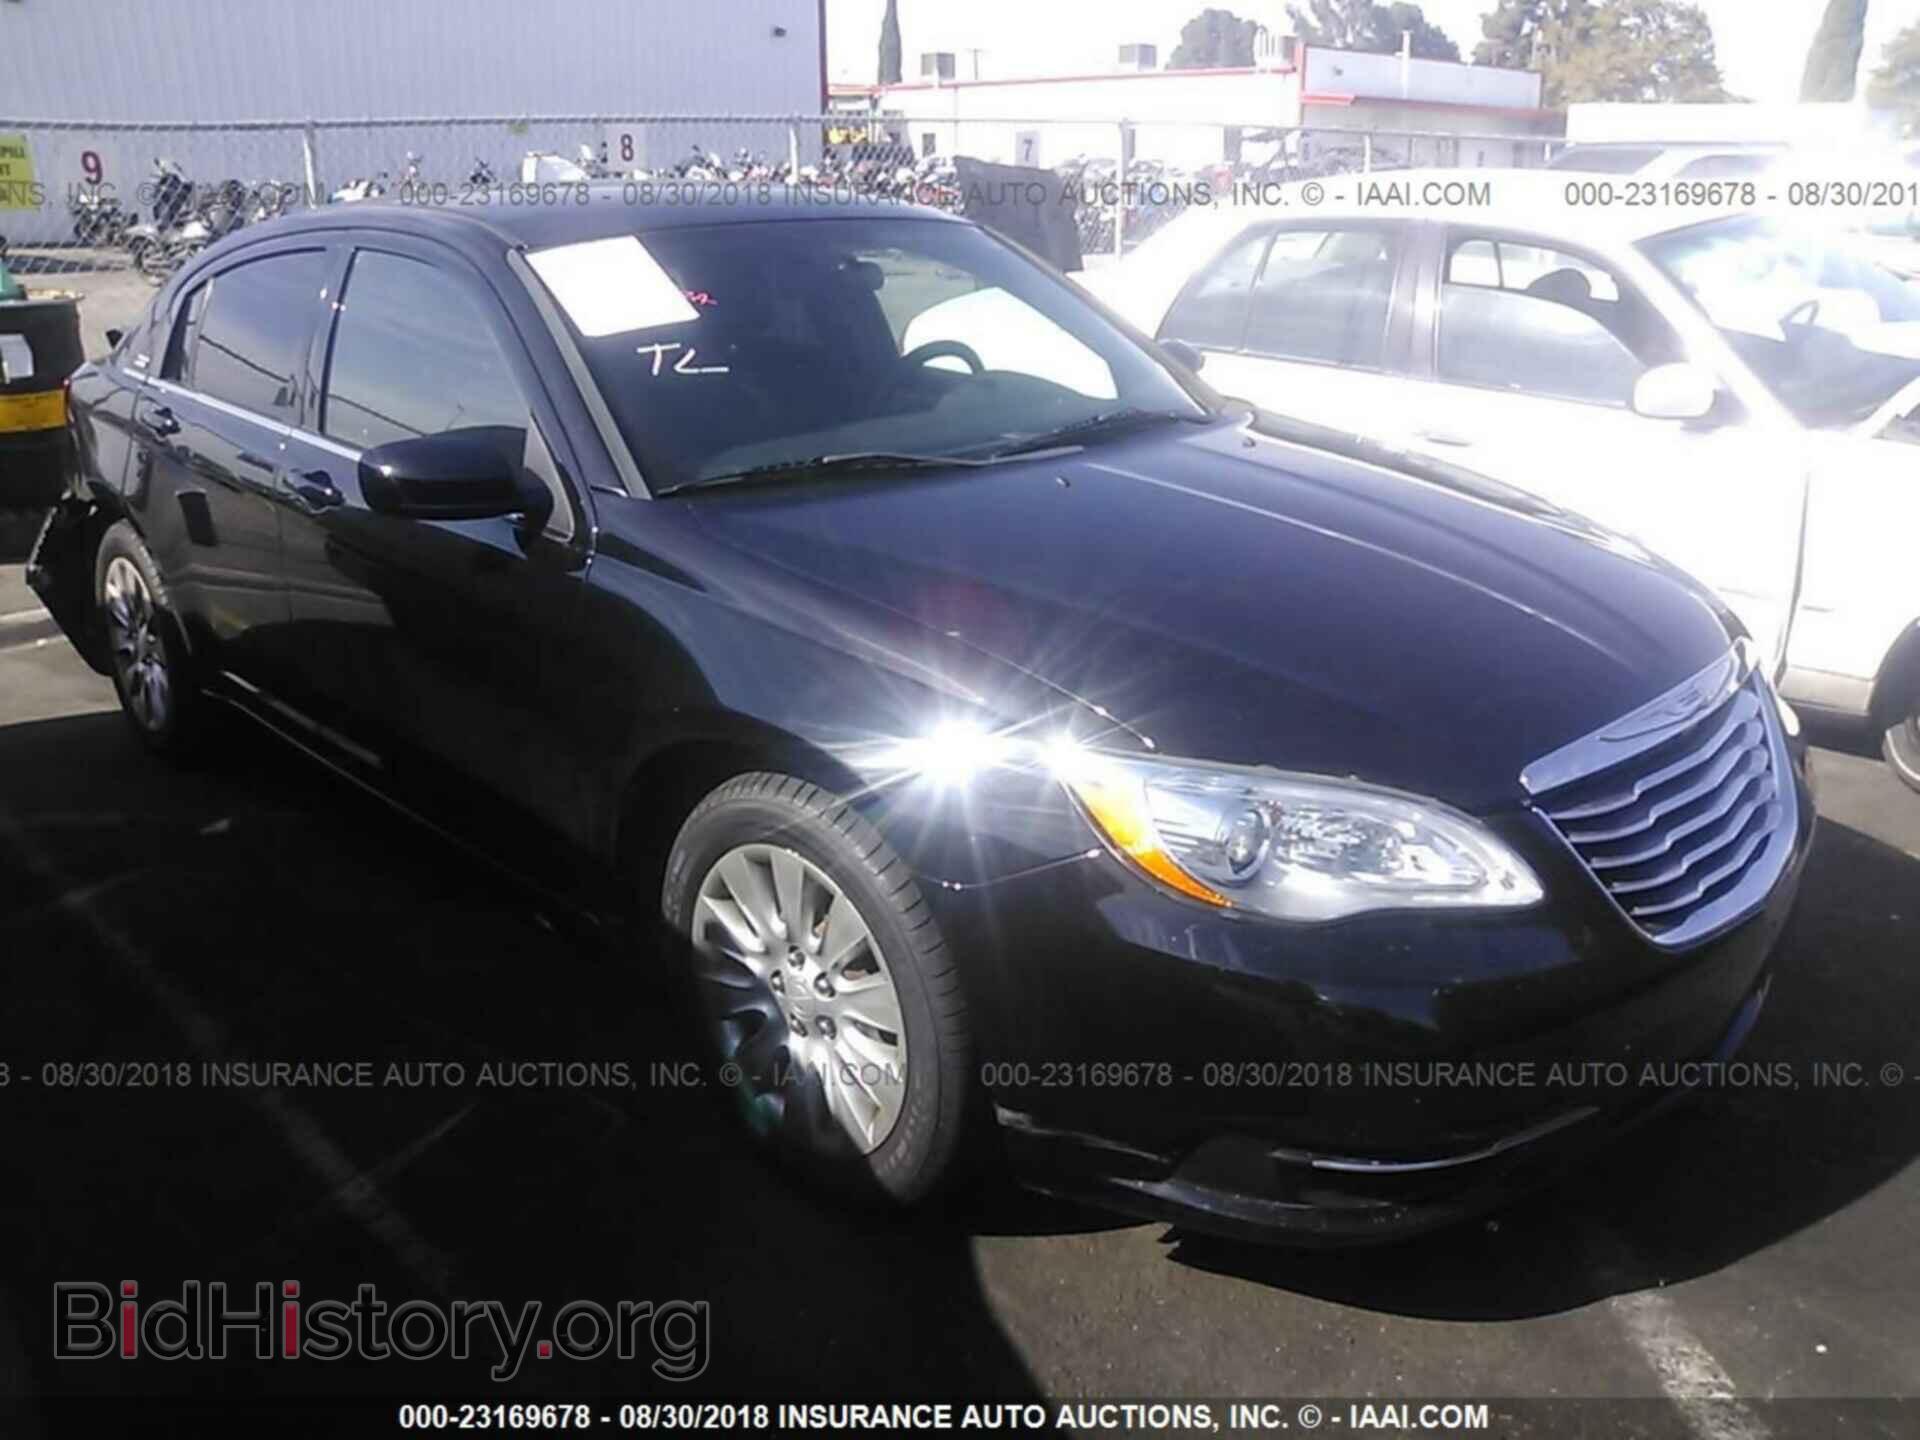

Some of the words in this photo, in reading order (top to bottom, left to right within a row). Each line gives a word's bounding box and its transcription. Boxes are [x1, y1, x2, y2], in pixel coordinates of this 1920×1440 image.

[620, 133, 634, 162] 8
[1023, 138, 1033, 162] 7
[81, 151, 103, 185] 9
